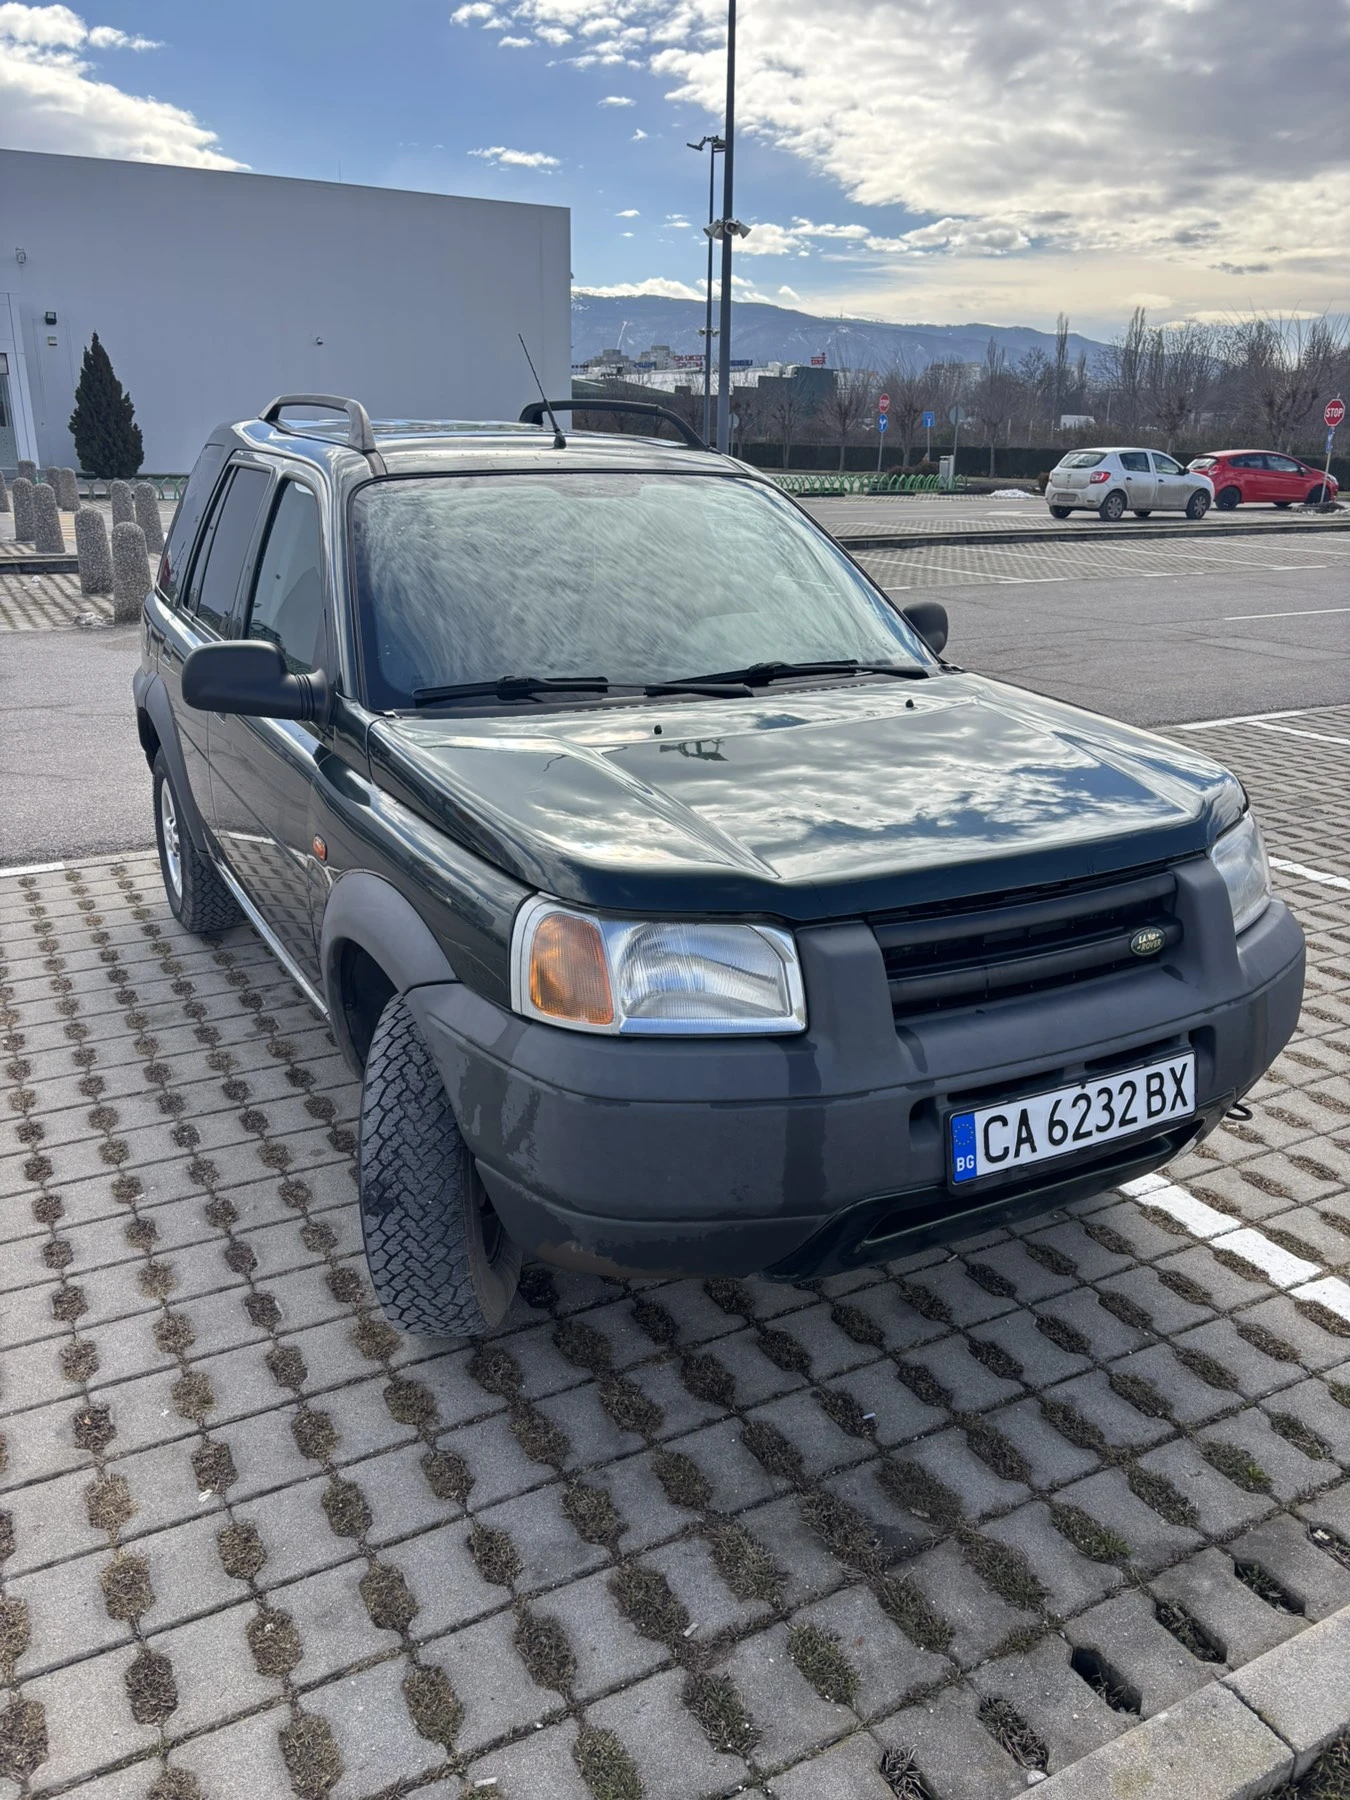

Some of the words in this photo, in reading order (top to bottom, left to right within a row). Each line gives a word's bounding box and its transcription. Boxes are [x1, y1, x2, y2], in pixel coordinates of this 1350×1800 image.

[1325, 407, 1343, 418] STOP
[1140, 938, 1162, 951] ROVER
[983, 1108, 1037, 1164] CA
[1048, 1080, 1138, 1147] 6232
[1146, 1062, 1189, 1119] BX
[956, 1155, 975, 1172] BG
